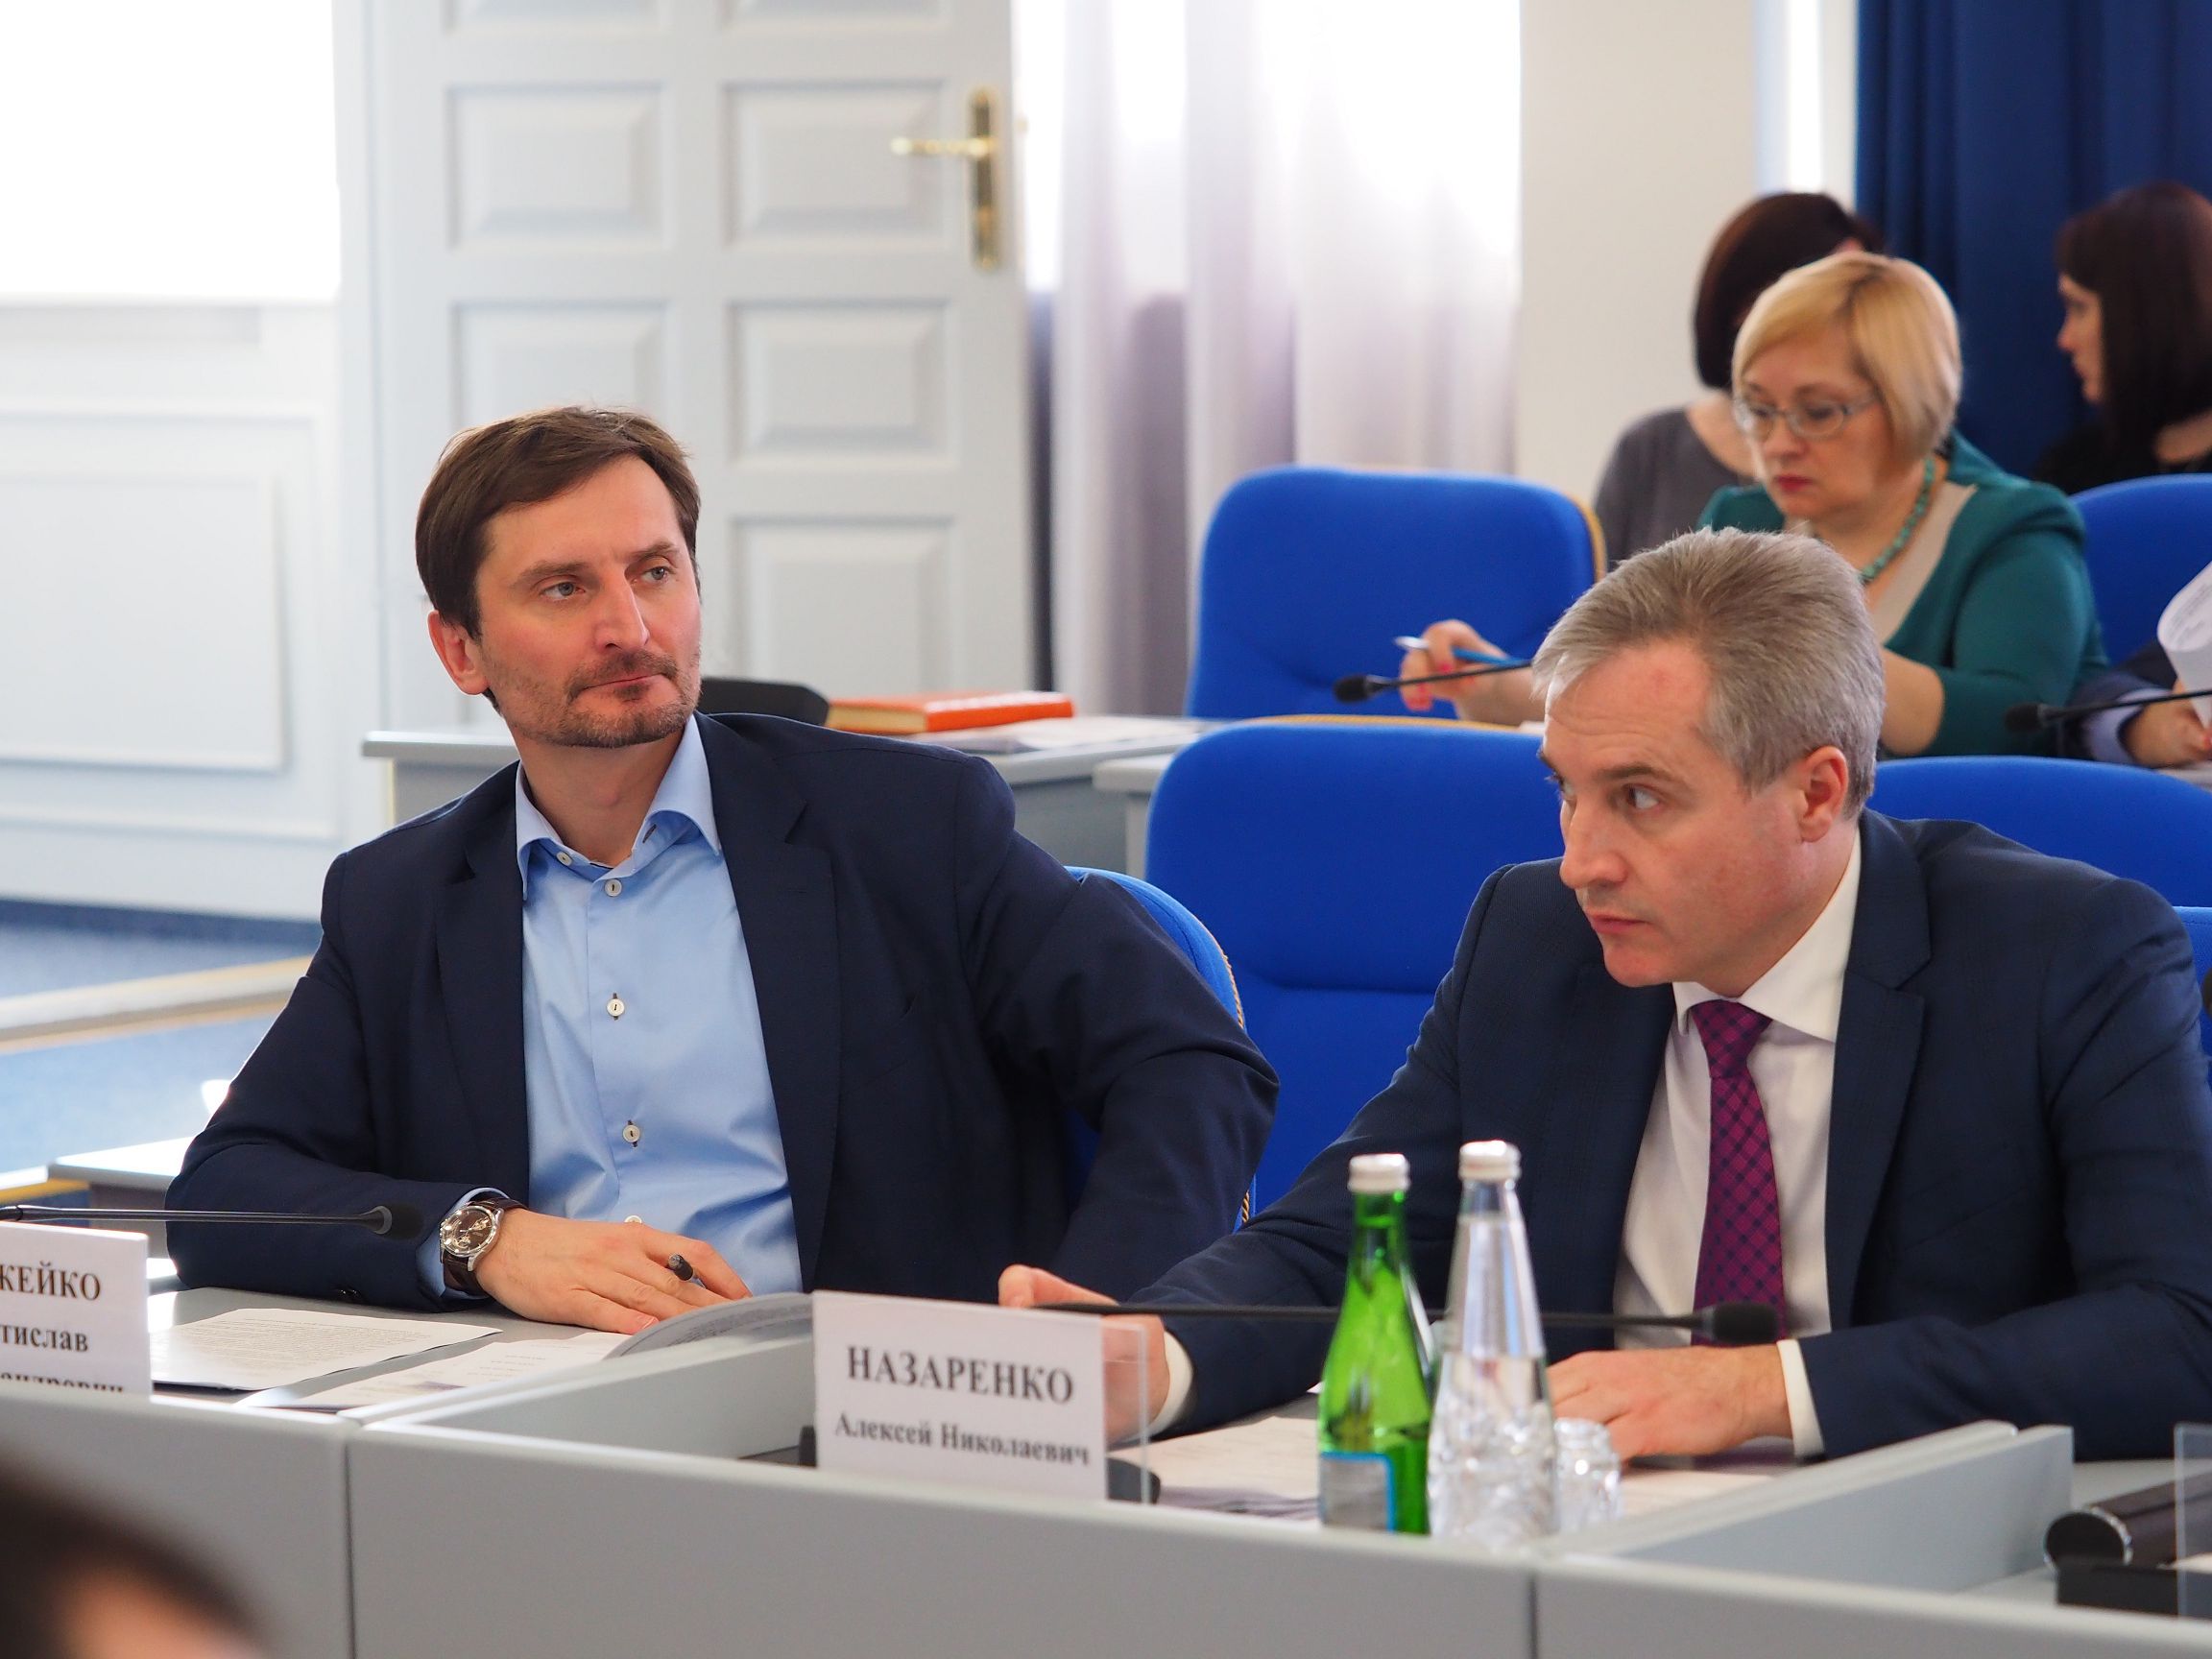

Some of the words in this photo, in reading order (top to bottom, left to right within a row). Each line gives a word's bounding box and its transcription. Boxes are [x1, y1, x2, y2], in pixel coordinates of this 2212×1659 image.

[0, 1260, 101, 1301] КЕЙКО
[0, 1324, 88, 1353] тислав
[847, 1346, 1073, 1403] НАЗАРЕНКО
[835, 1411, 931, 1447] Алексей
[940, 1423, 1090, 1466] Николаевич
